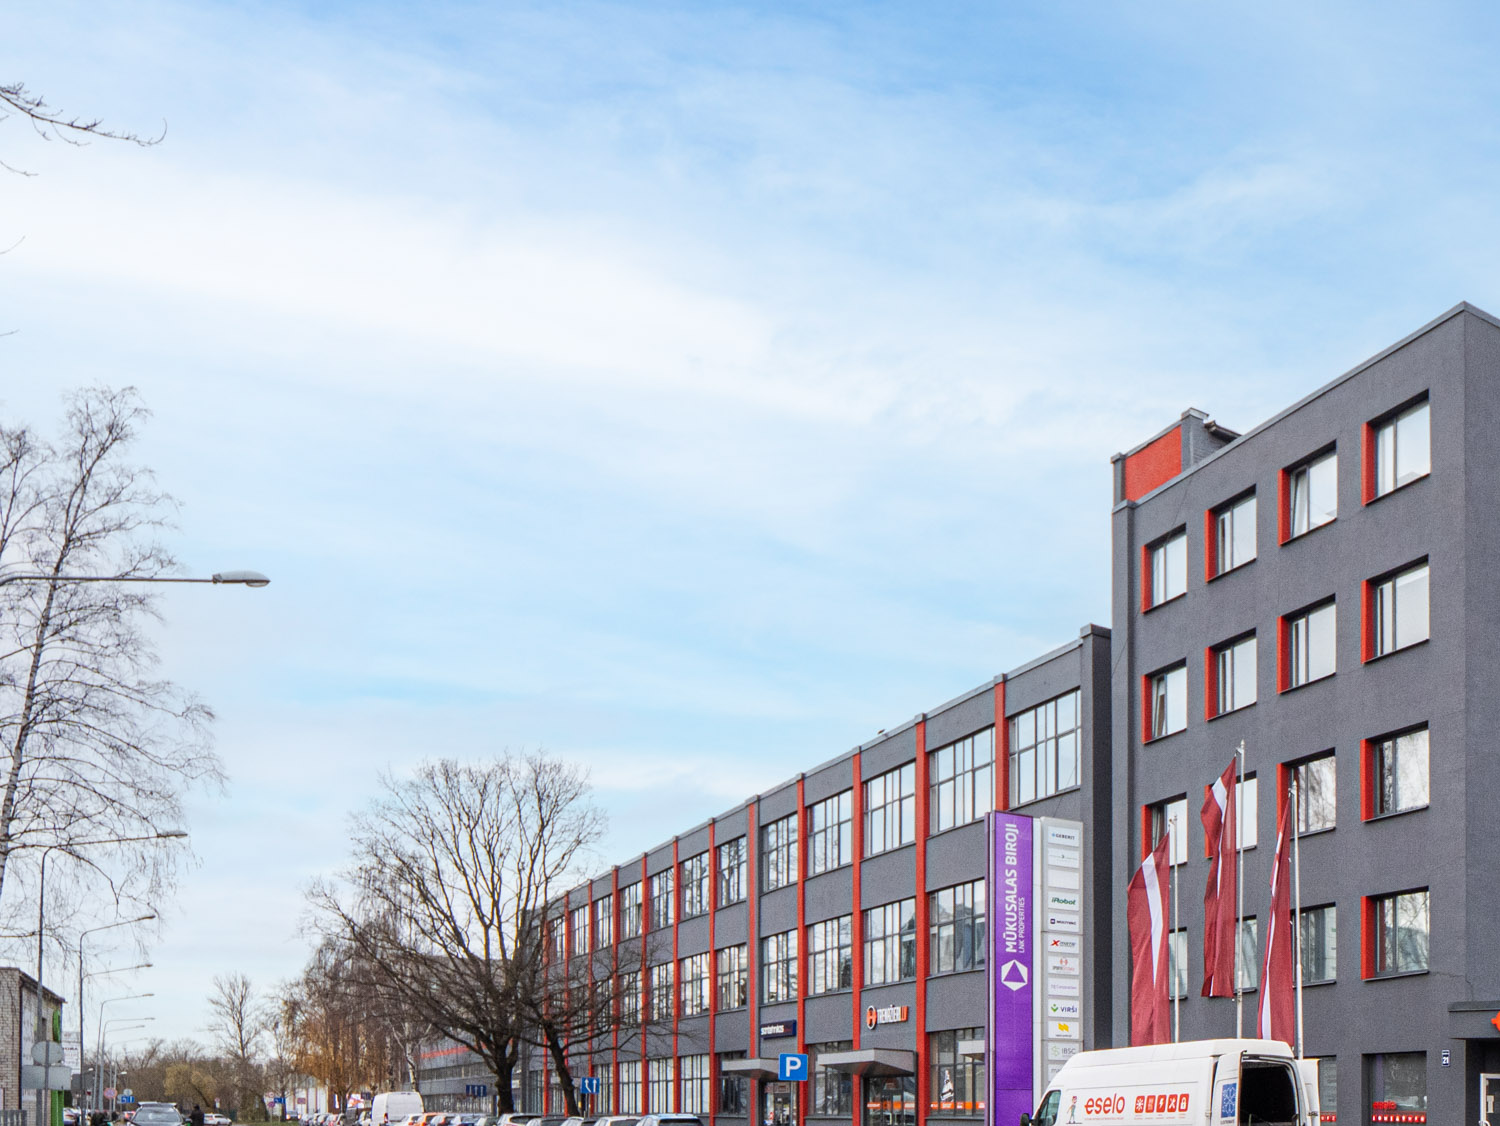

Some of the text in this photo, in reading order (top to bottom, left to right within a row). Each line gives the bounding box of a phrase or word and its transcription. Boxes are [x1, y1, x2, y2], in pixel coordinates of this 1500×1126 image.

[1003, 823, 1019, 953] MŪKUSALAS BIROJI
[1051, 897, 1077, 906] iRobot
[785, 1056, 801, 1077] P
[1084, 1093, 1126, 1115] eselo
